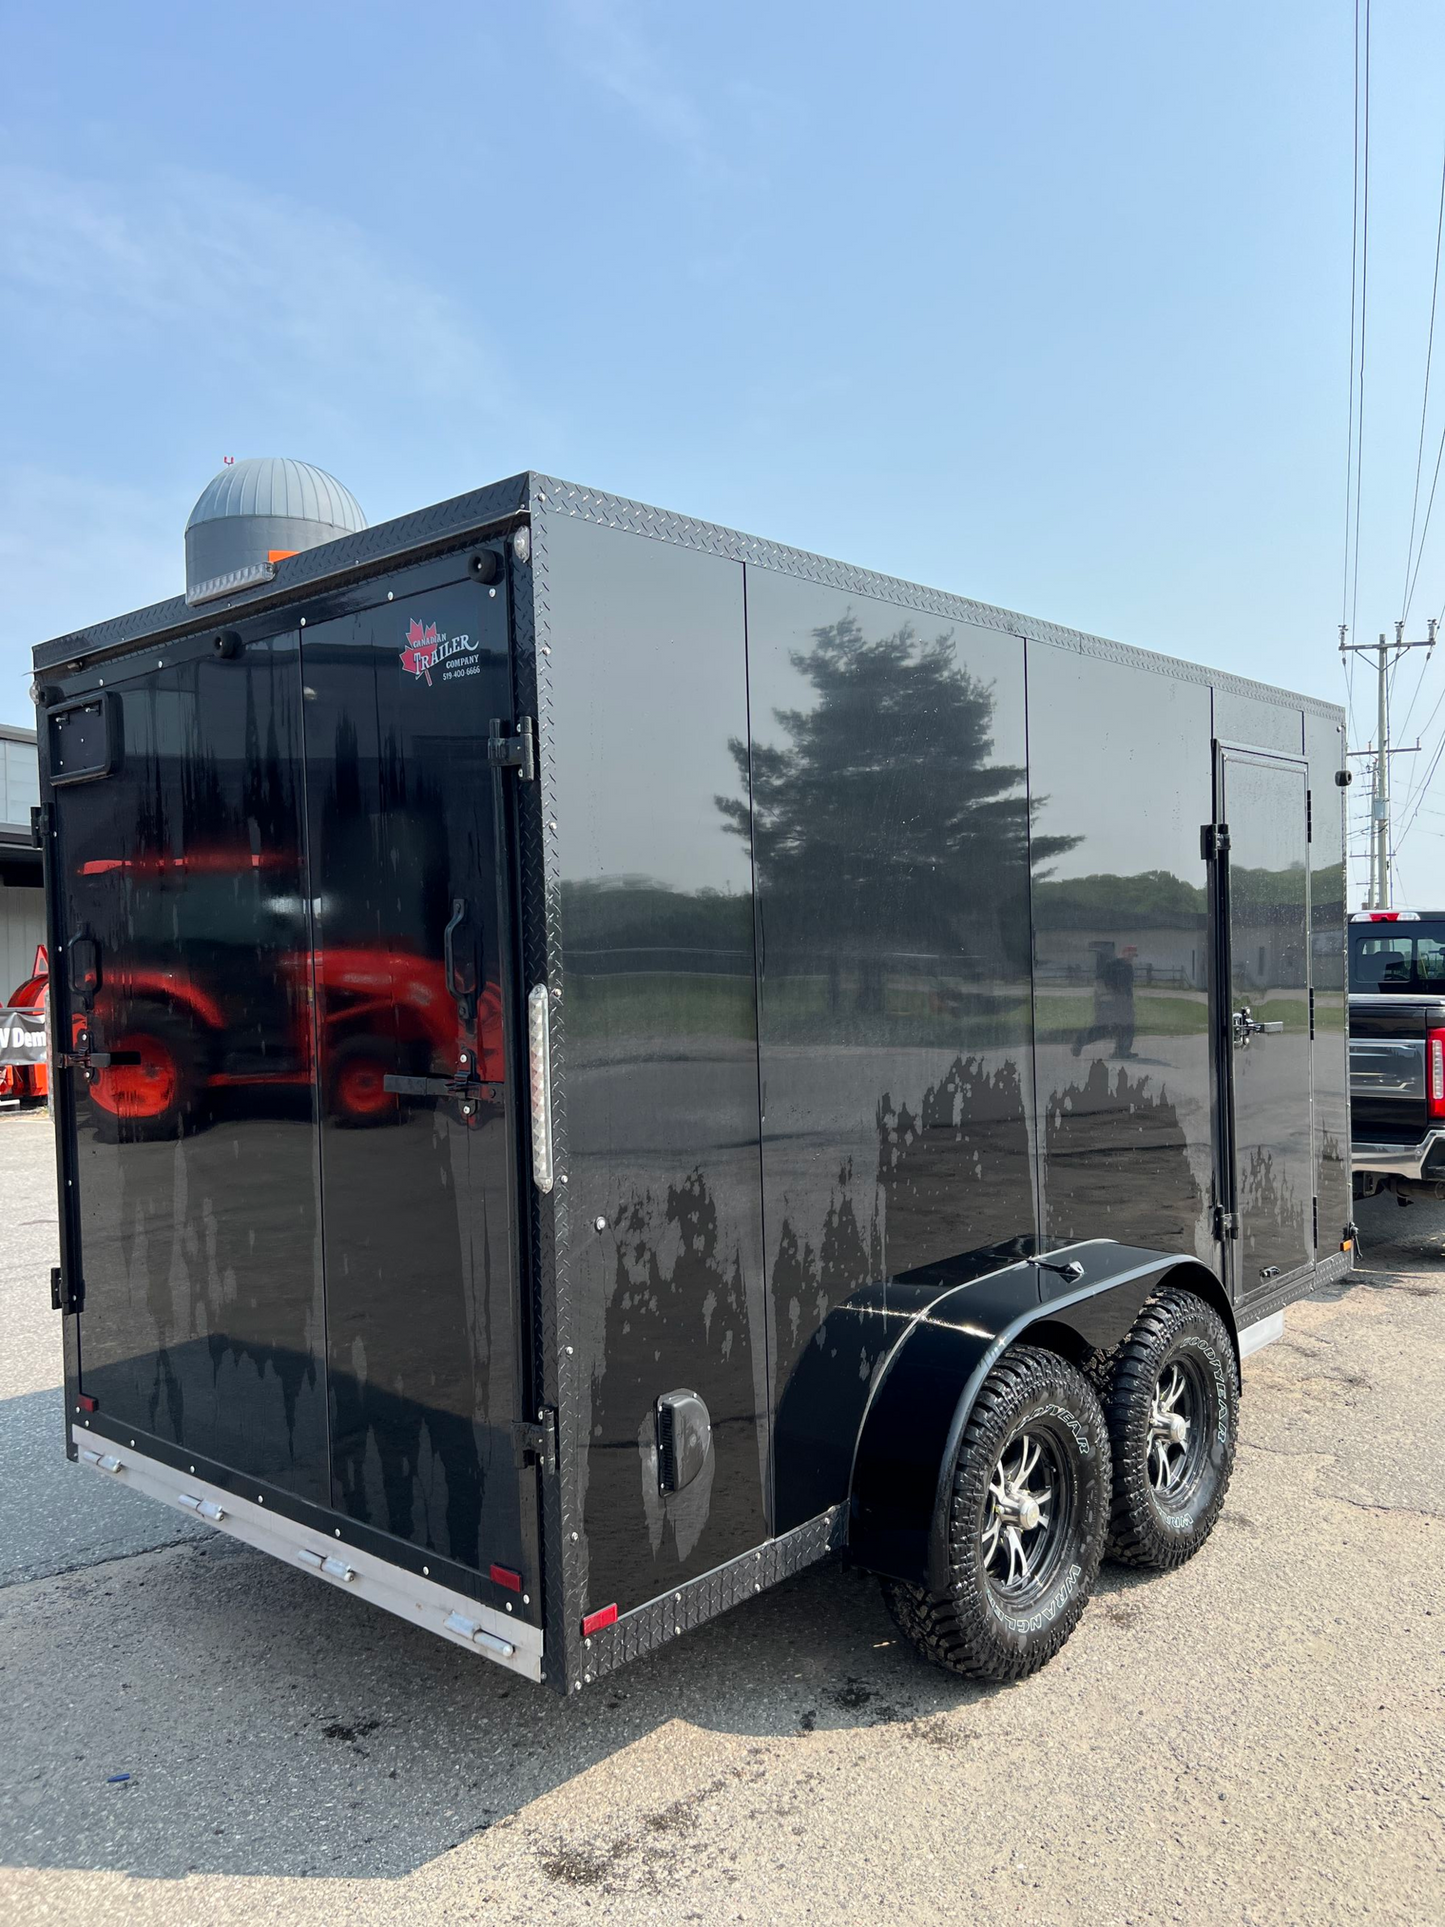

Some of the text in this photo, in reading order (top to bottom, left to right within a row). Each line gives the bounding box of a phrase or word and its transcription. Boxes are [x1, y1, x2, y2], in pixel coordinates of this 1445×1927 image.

[413, 633, 447, 648] CANADIAN
[413, 634, 480, 675] TRAILER
[445, 654, 479, 668] COMPANY
[1179, 1336, 1229, 1443] GOODYEAR
[998, 1403, 1090, 1456] ODYEAR
